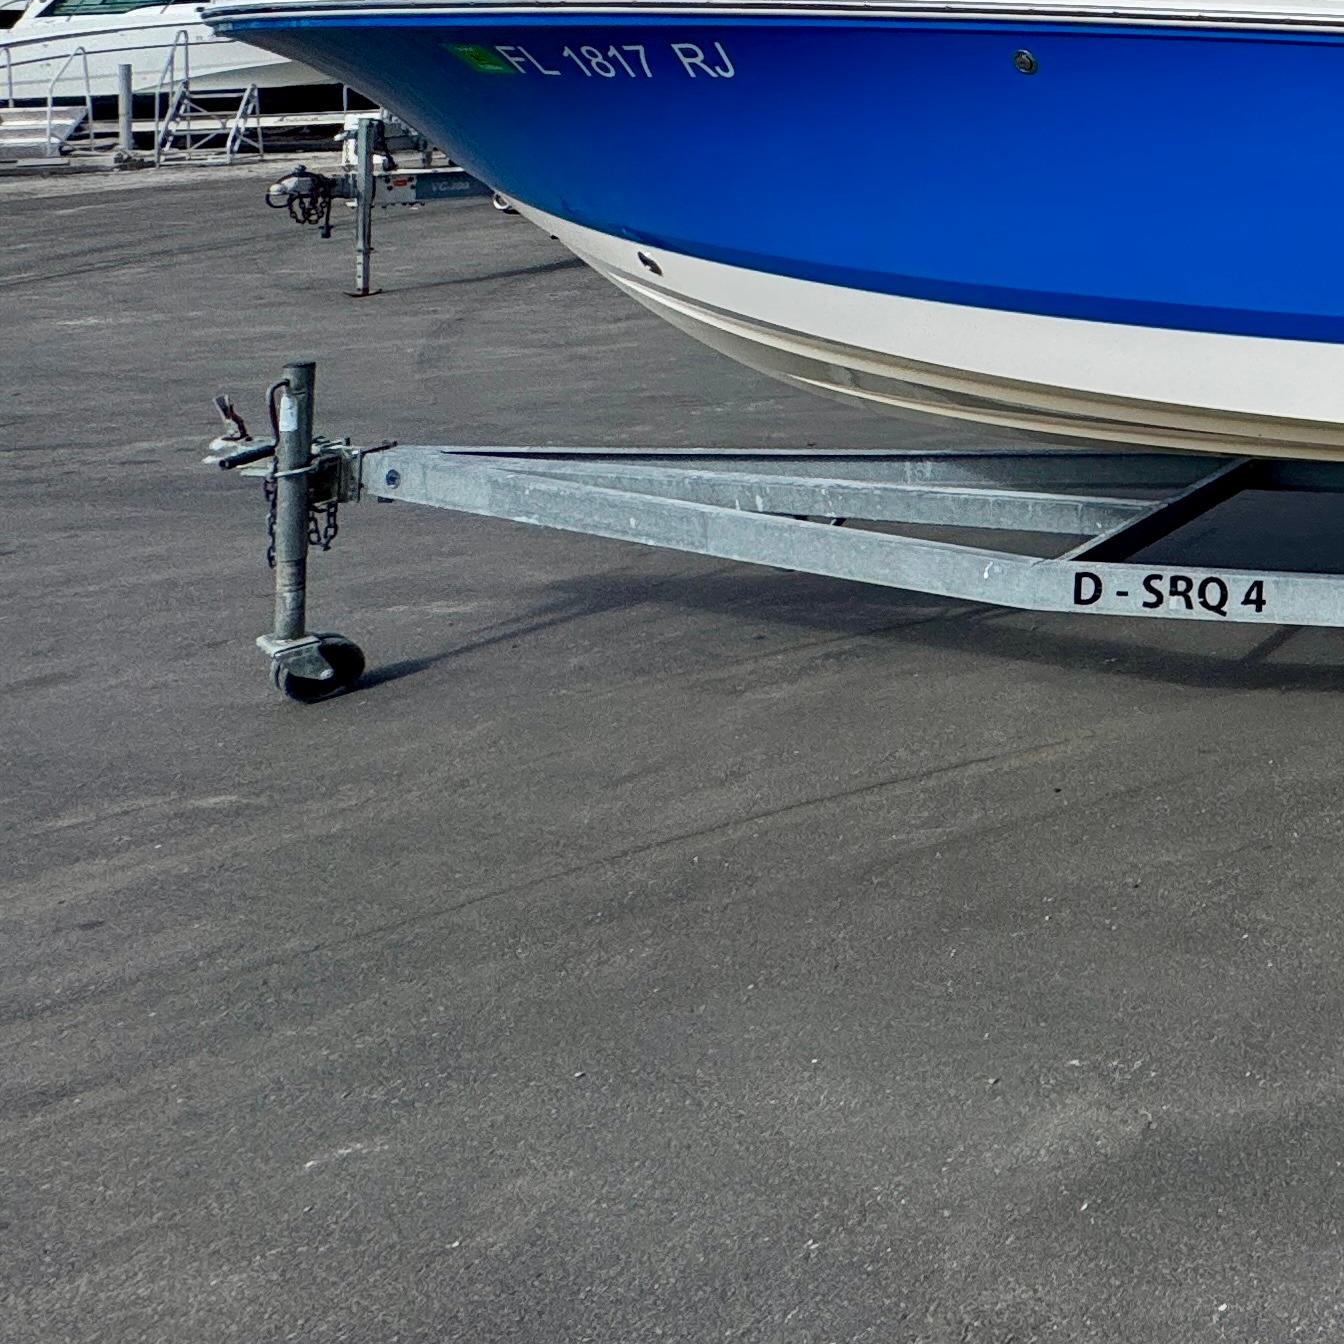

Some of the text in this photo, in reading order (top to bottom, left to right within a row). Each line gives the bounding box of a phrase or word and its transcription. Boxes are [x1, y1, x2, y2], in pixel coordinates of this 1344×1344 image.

[496, 46, 561, 75] FL
[563, 45, 653, 77] 1817
[671, 42, 735, 78] RJ
[1073, 571, 1103, 606] D
[1142, 573, 1229, 617] SRQ
[1240, 580, 1267, 613] 4
